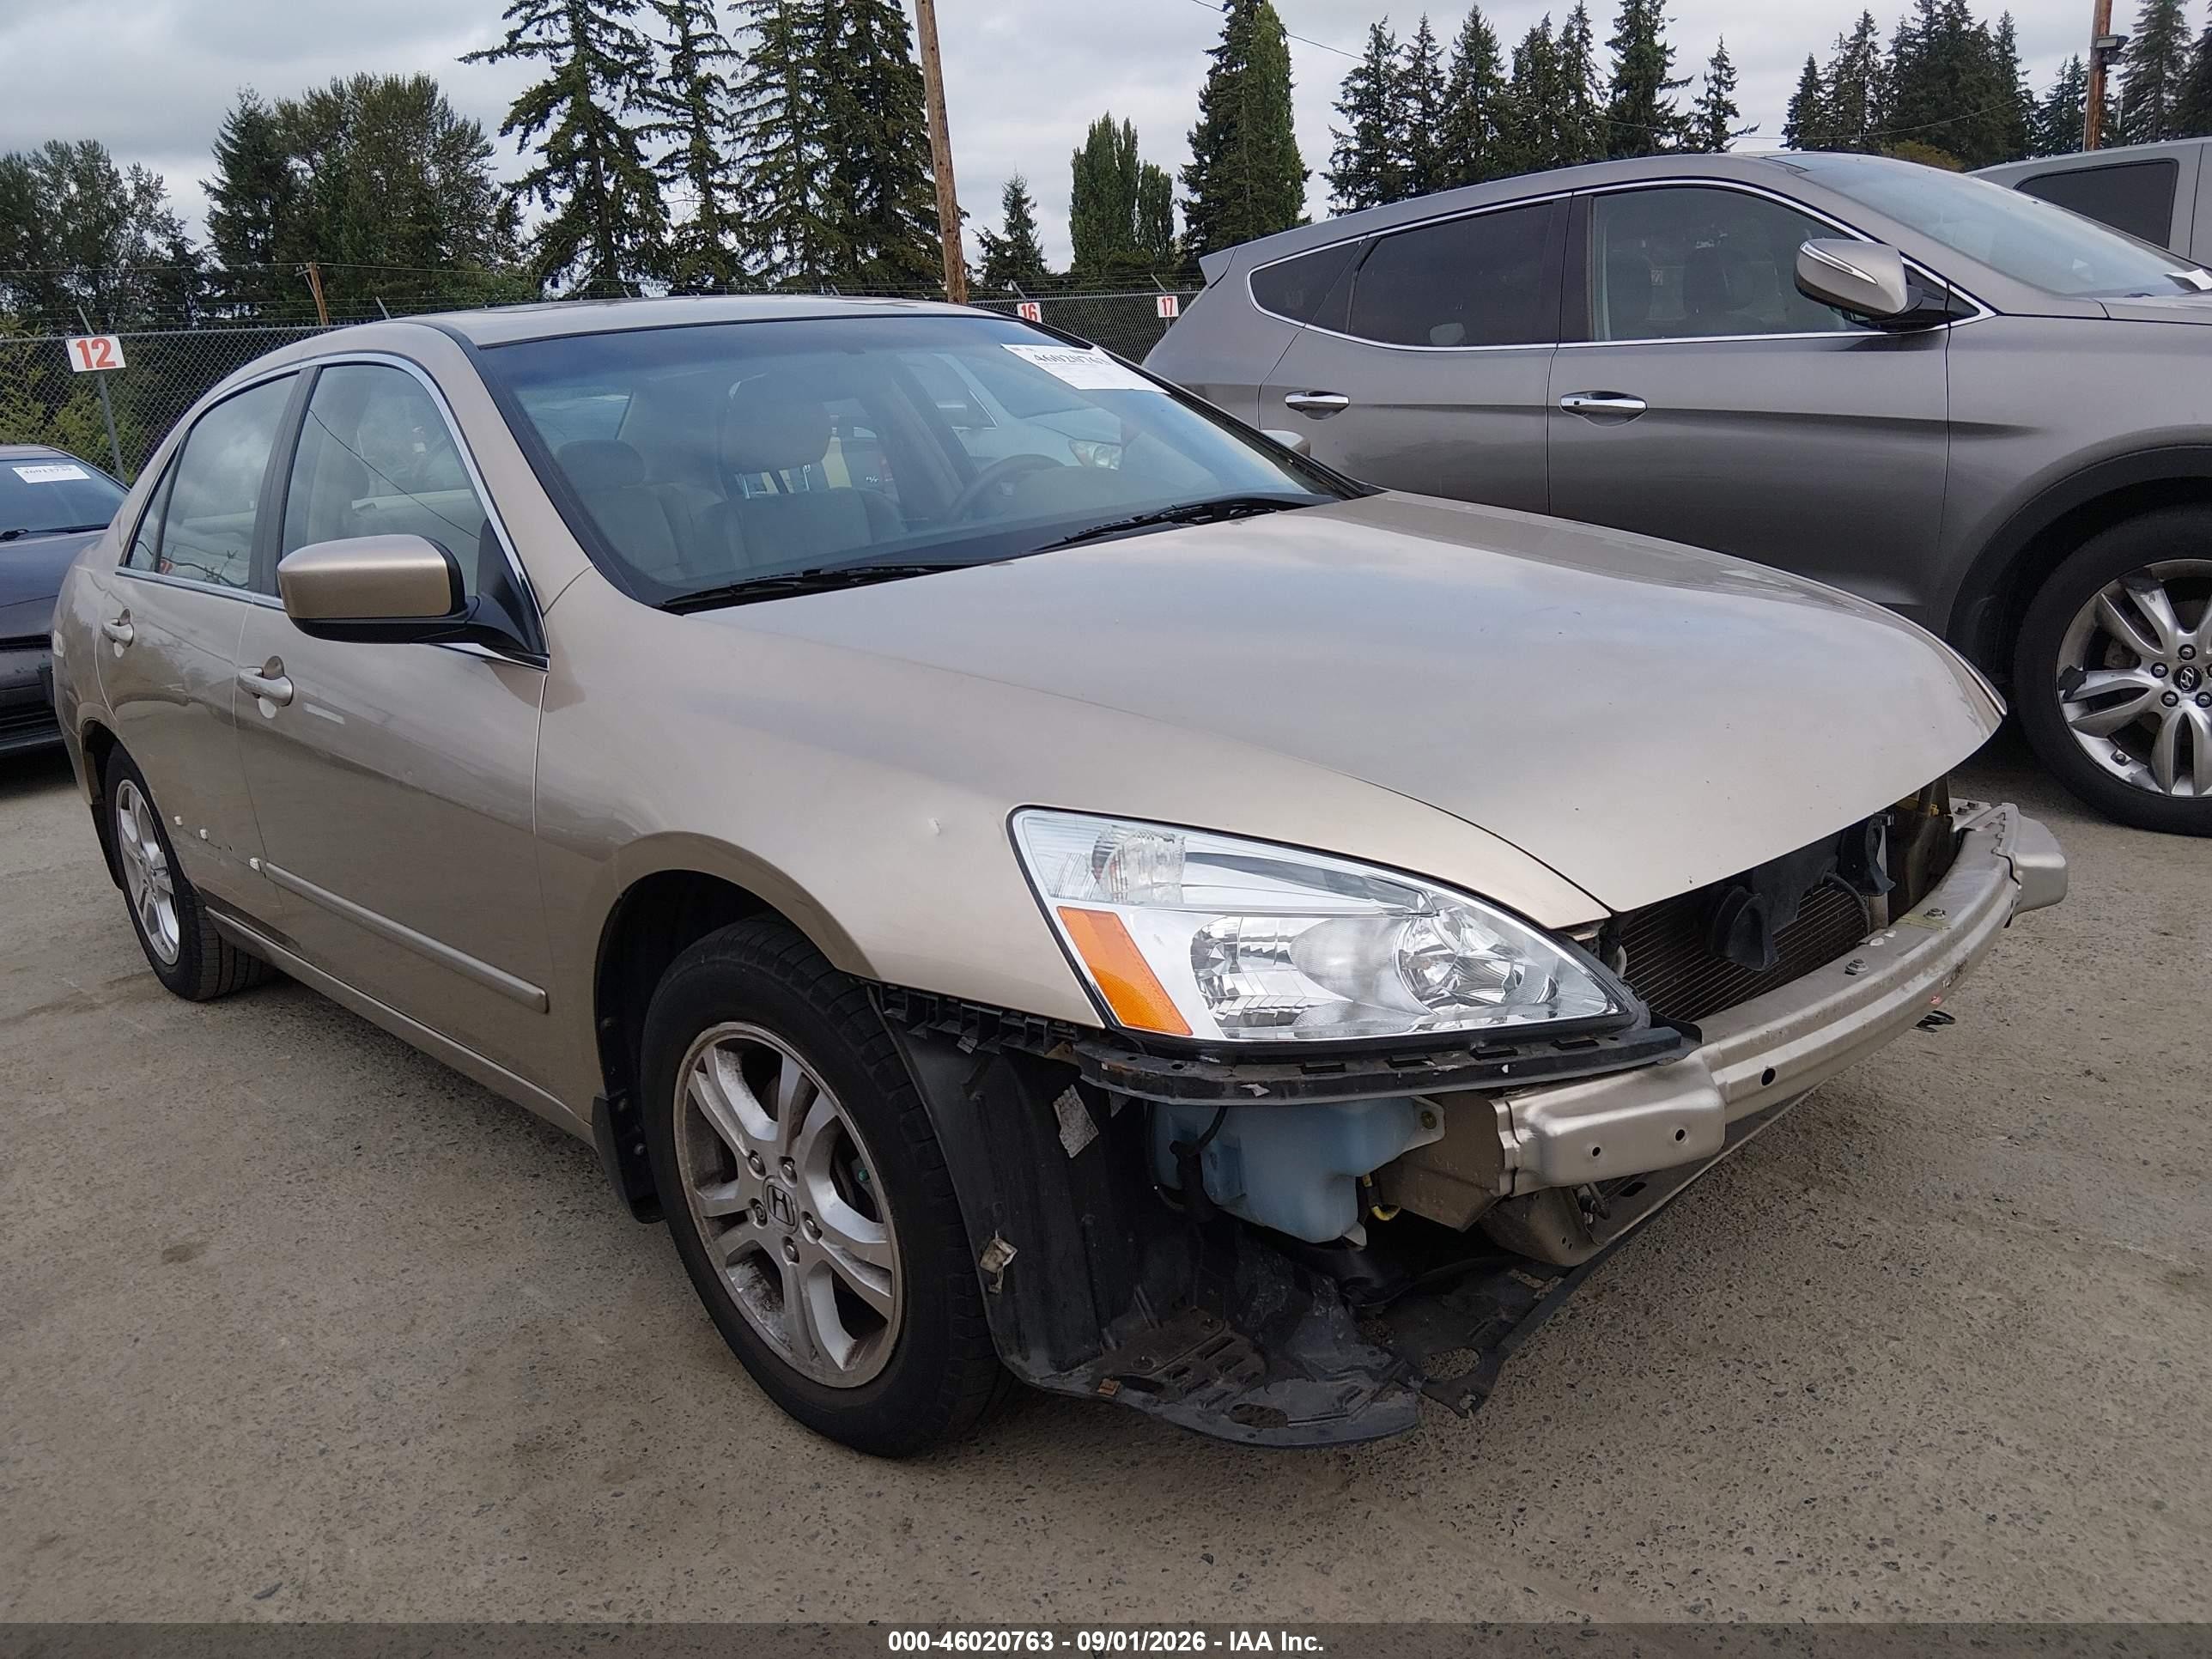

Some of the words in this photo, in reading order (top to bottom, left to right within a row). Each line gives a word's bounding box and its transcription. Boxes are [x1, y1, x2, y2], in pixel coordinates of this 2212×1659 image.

[1021, 303, 1038, 322] 16
[1161, 297, 1174, 317] 17
[76, 337, 117, 369] 12
